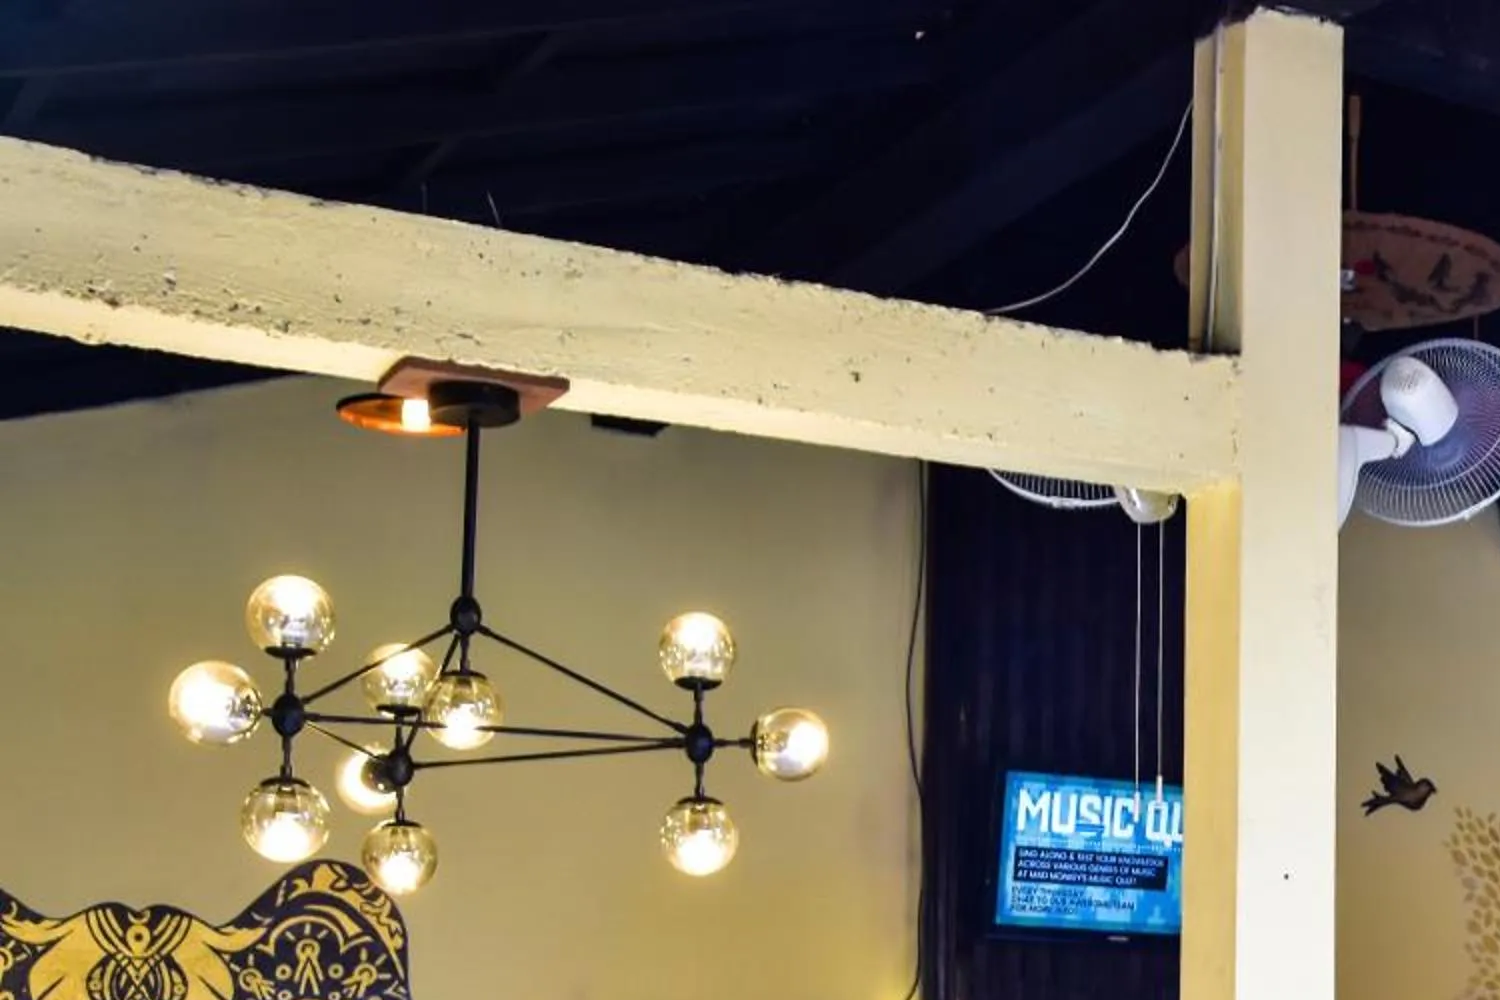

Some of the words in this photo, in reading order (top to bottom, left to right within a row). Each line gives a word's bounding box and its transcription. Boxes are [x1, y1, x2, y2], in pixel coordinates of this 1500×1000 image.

[1016, 788, 1135, 839] MUSIC
[1040, 850, 1067, 860] ALONG
[1017, 860, 1051, 870] ACROSS
[1053, 862, 1087, 872] VARIOUS
[1132, 867, 1156, 877] MUSIC
[1089, 874, 1113, 884] MUSIC
